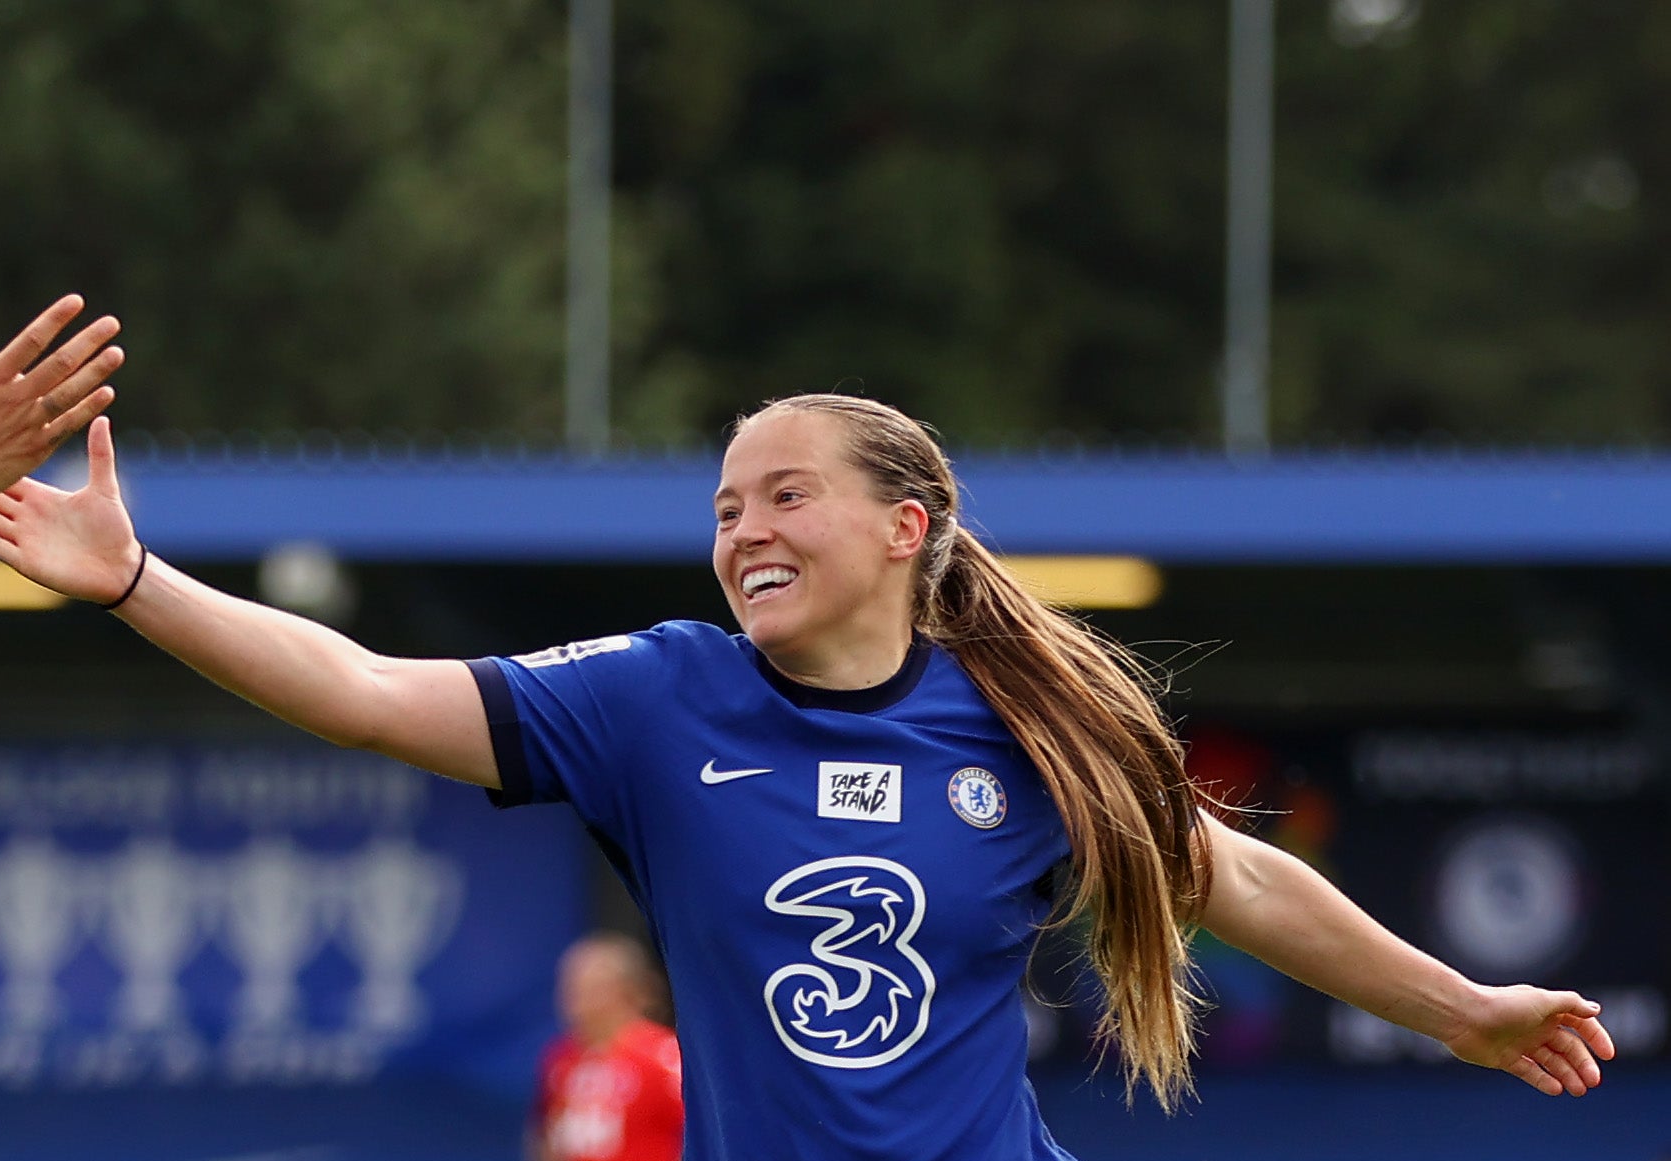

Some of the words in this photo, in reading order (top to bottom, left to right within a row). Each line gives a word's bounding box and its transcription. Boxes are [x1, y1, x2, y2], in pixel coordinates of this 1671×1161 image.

[830, 771, 873, 789] TAKE
[877, 770, 891, 789] A
[958, 769, 996, 787] CHELSEA
[829, 788, 887, 815] STAND.
